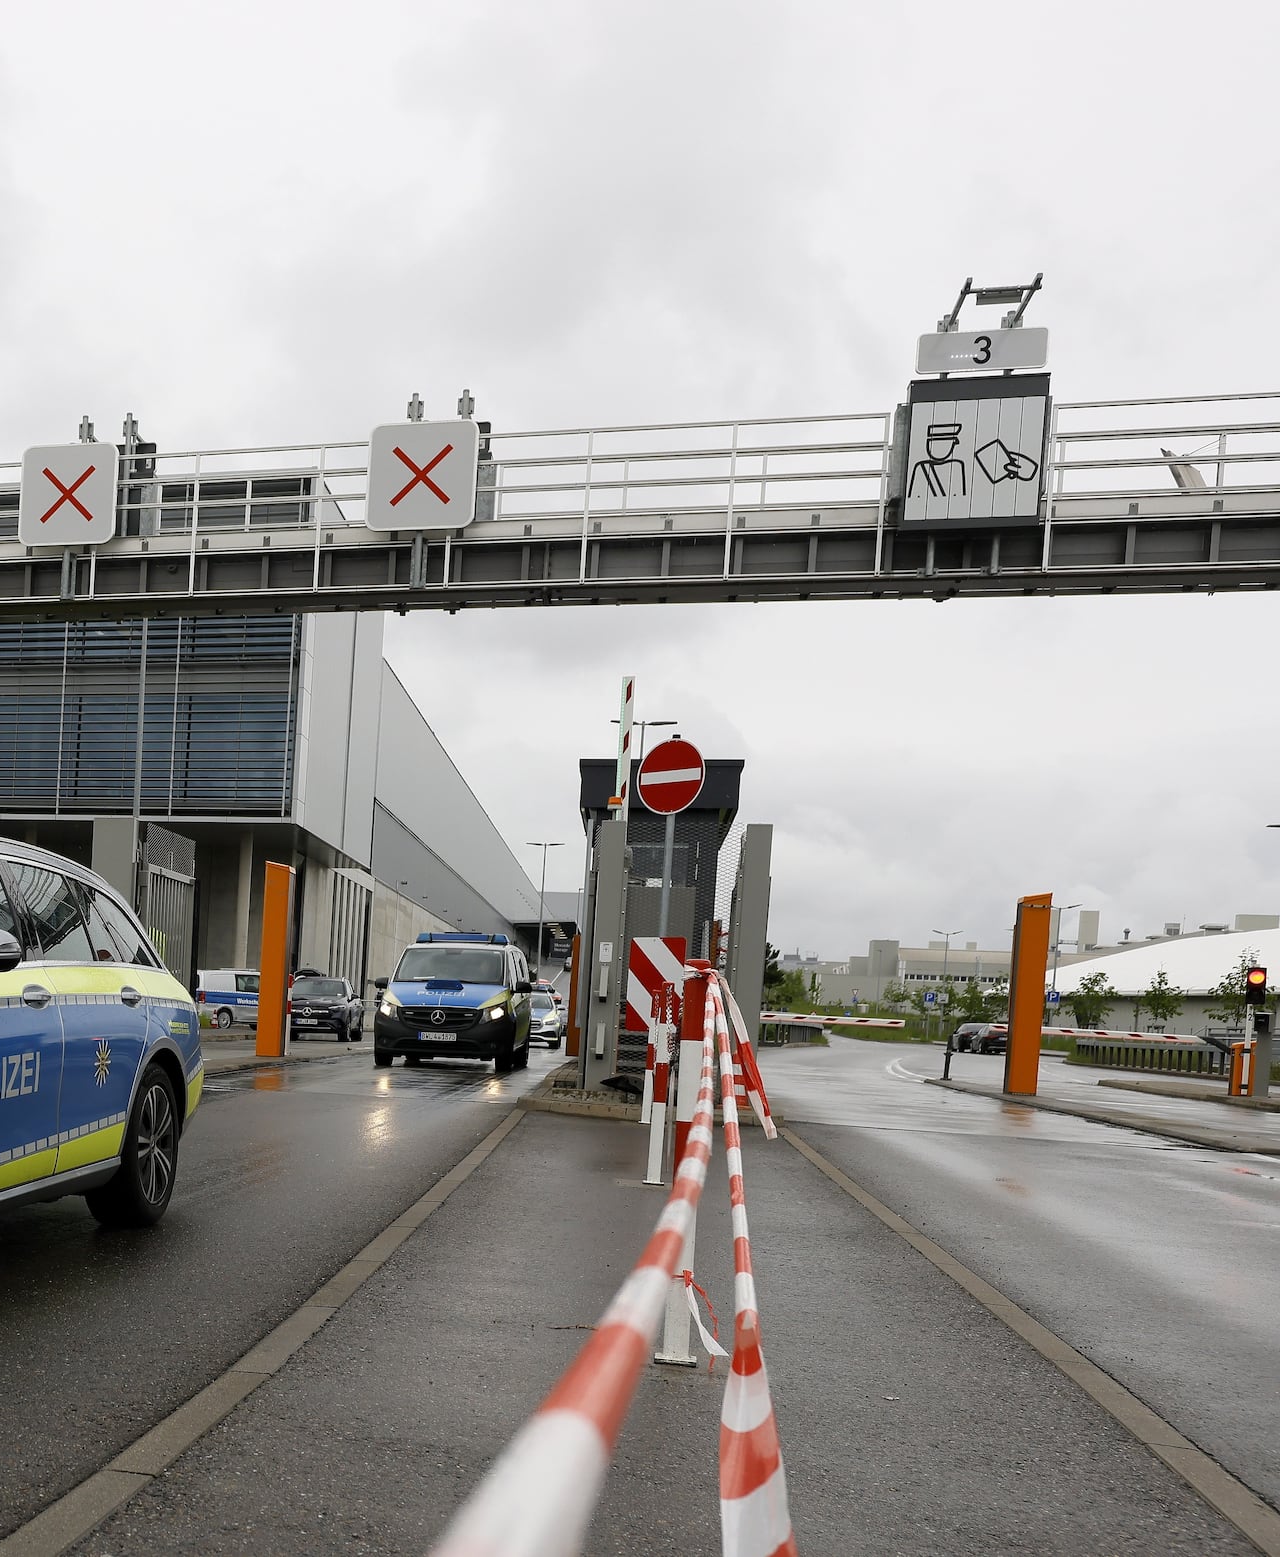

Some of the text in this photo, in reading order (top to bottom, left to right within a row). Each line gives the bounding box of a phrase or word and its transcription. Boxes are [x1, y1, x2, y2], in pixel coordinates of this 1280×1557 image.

[972, 335, 992, 365] 3
[236, 997, 259, 1005] Werksch
[1248, 1013, 1253, 1021] 2
